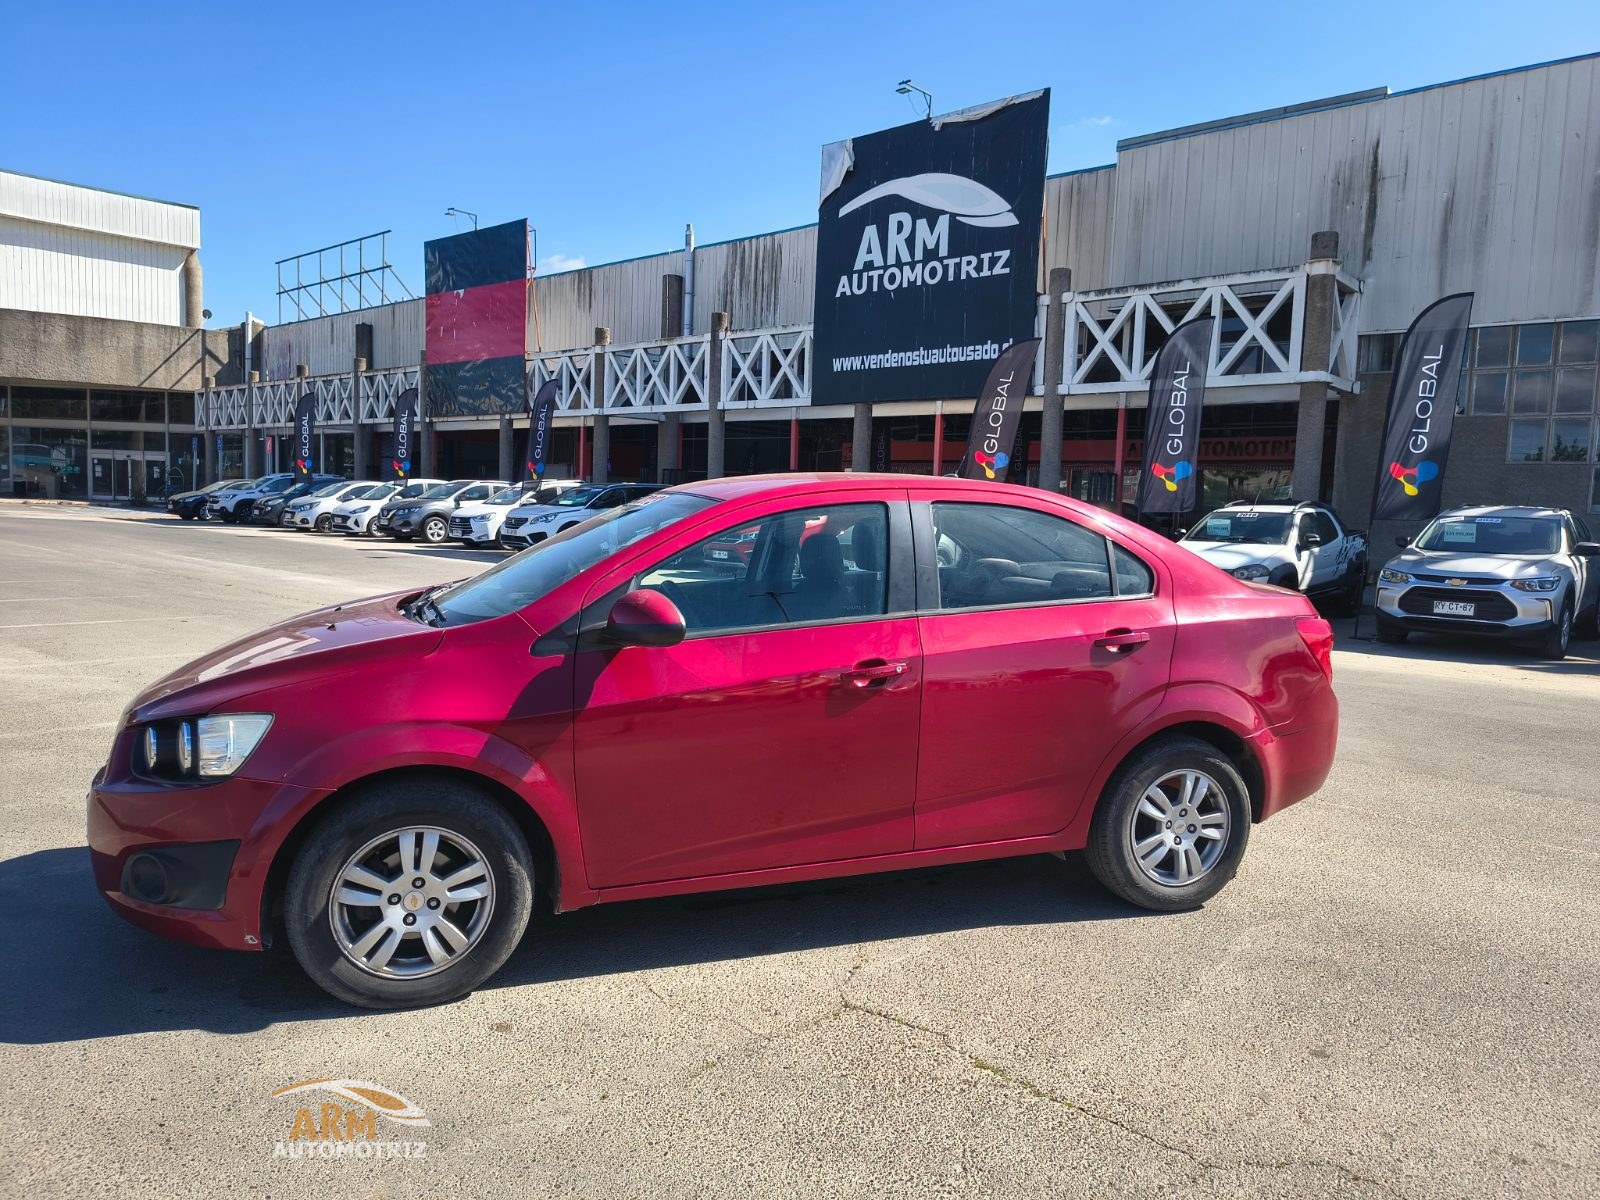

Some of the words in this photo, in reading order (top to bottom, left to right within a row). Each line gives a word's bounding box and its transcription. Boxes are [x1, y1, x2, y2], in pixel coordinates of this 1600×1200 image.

[853, 212, 950, 271] ARM
[835, 249, 1011, 298] AUTOMOTRIZ
[984, 370, 1015, 454] GLOBAL
[1167, 361, 1191, 455] GLOBAL
[1409, 344, 1444, 454] GLOBAL
[301, 412, 310, 458] GLOBAL
[397, 409, 409, 459] GLOBAL
[534, 403, 548, 459] GLOBAL
[1202, 439, 1296, 457] TOMOTRI
